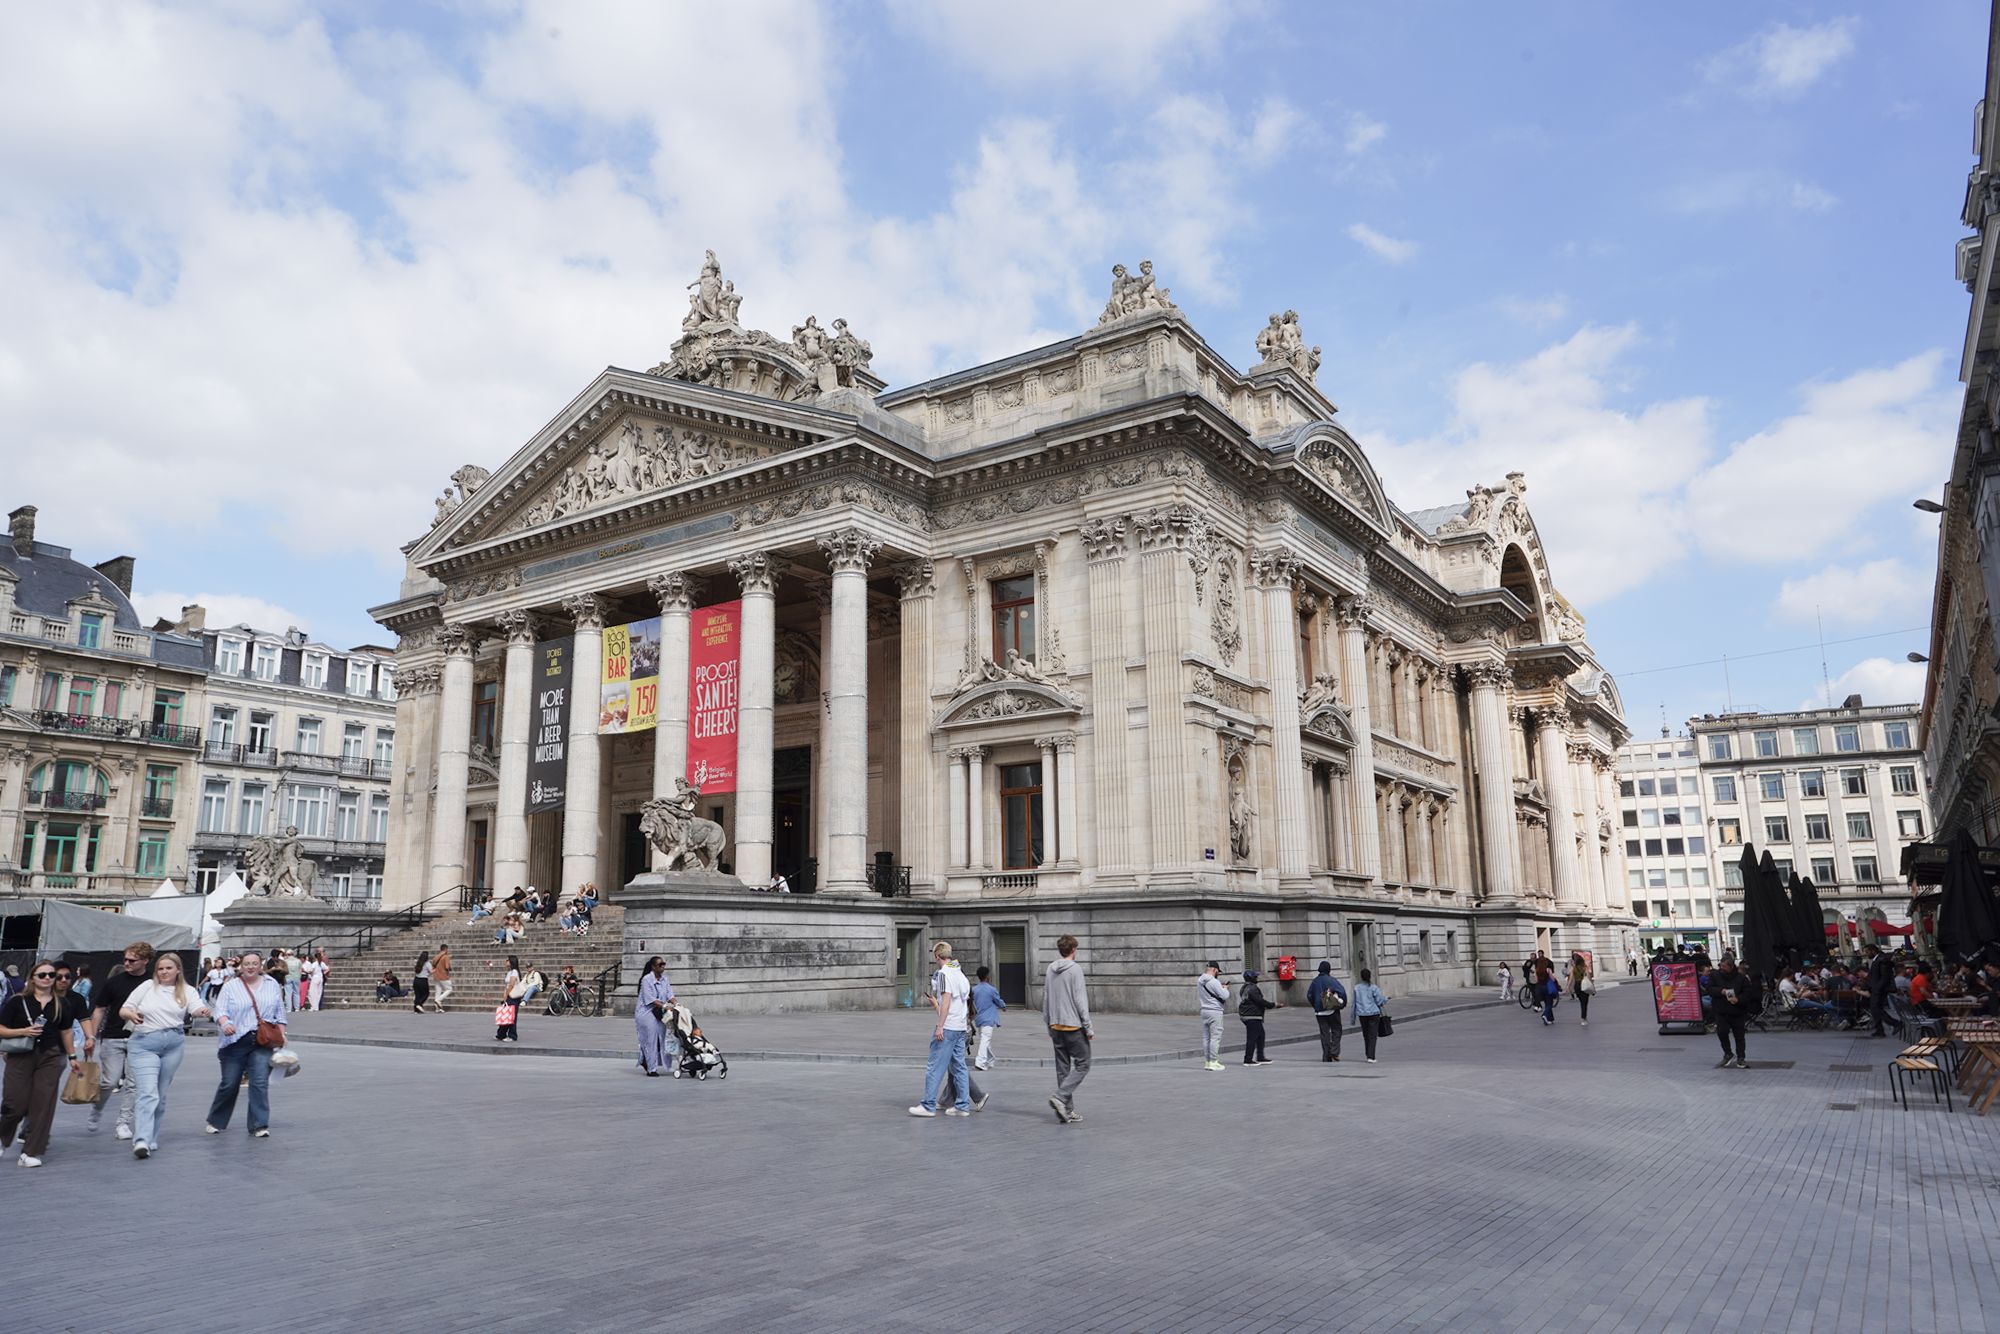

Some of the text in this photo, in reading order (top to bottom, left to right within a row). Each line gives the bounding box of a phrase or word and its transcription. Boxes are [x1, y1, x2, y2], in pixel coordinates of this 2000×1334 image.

[608, 631, 625, 642] ROOF
[608, 641, 625, 656] TOP
[608, 656, 627, 679] BAR
[695, 660, 737, 683] PROOST
[540, 688, 565, 709] MORE
[636, 684, 656, 715] 150
[696, 677, 737, 711] SANTÉ!
[542, 707, 559, 726] THAN
[695, 707, 737, 739] CHEERS
[538, 725, 561, 744] A BEER
[535, 742, 563, 763] MUSEUM
